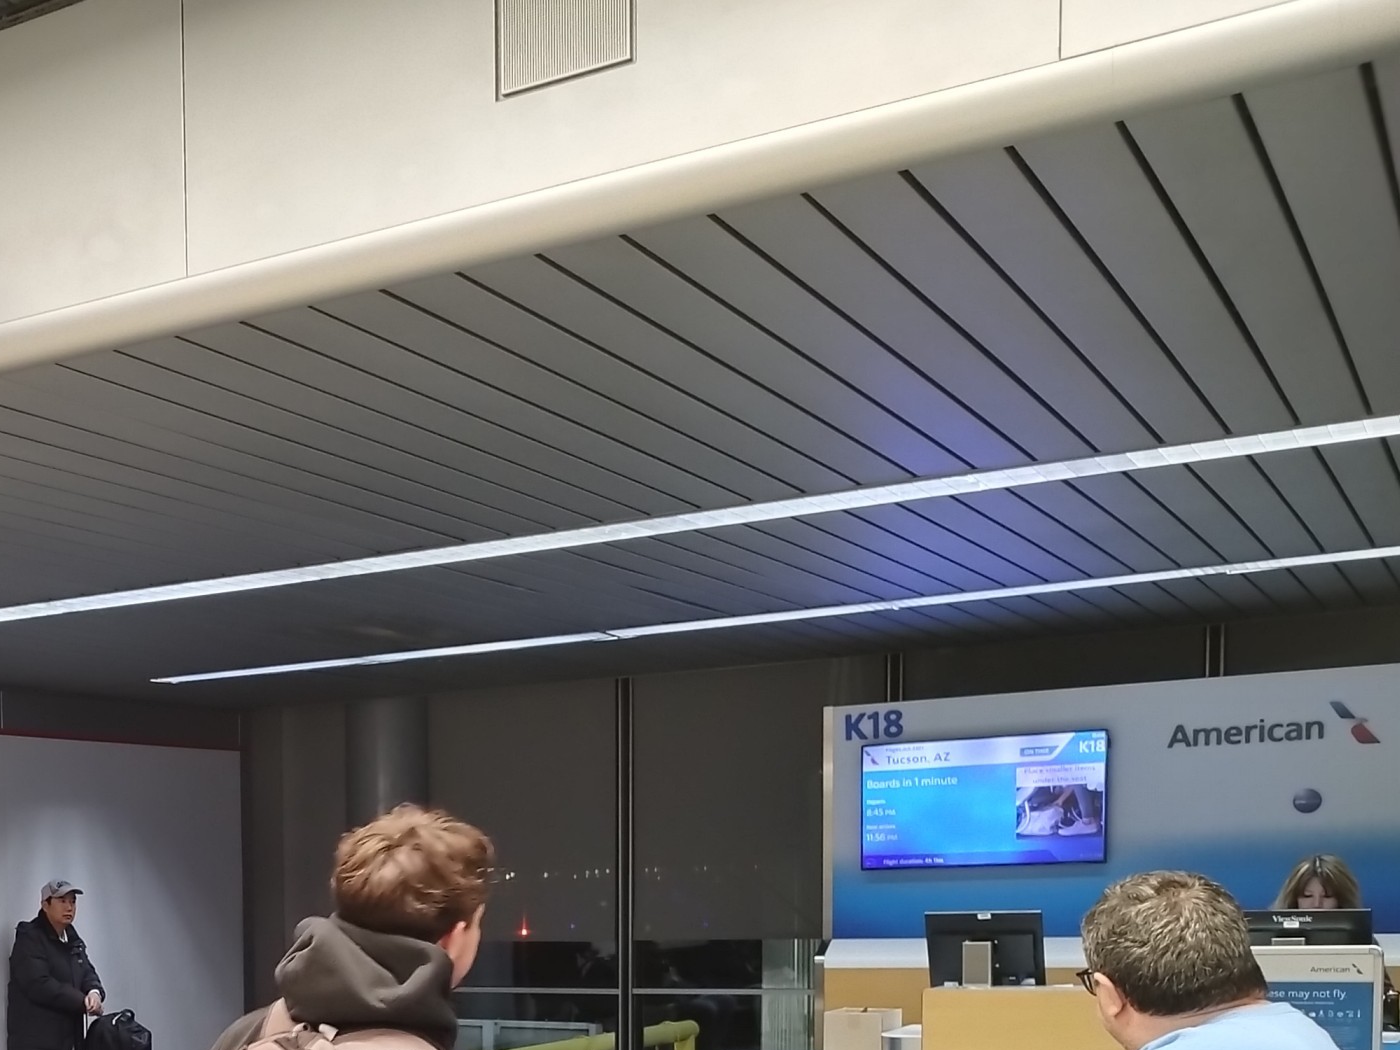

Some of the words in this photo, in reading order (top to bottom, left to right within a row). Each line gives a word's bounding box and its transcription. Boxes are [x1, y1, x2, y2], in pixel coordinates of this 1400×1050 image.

[845, 709, 904, 741] K18
[1166, 718, 1325, 749] American
[1079, 739, 1105, 753] K18
[933, 752, 950, 762] AZ
[866, 779, 900, 790] Boards
[902, 778, 912, 787] in
[914, 776, 919, 787] 1
[920, 776, 958, 787] minute
[1272, 914, 1313, 923] ViewSonic
[1309, 966, 1351, 974] American
[1267, 990, 1285, 998] ese
[1287, 990, 1310, 1001] may
[1312, 990, 1330, 998] not
